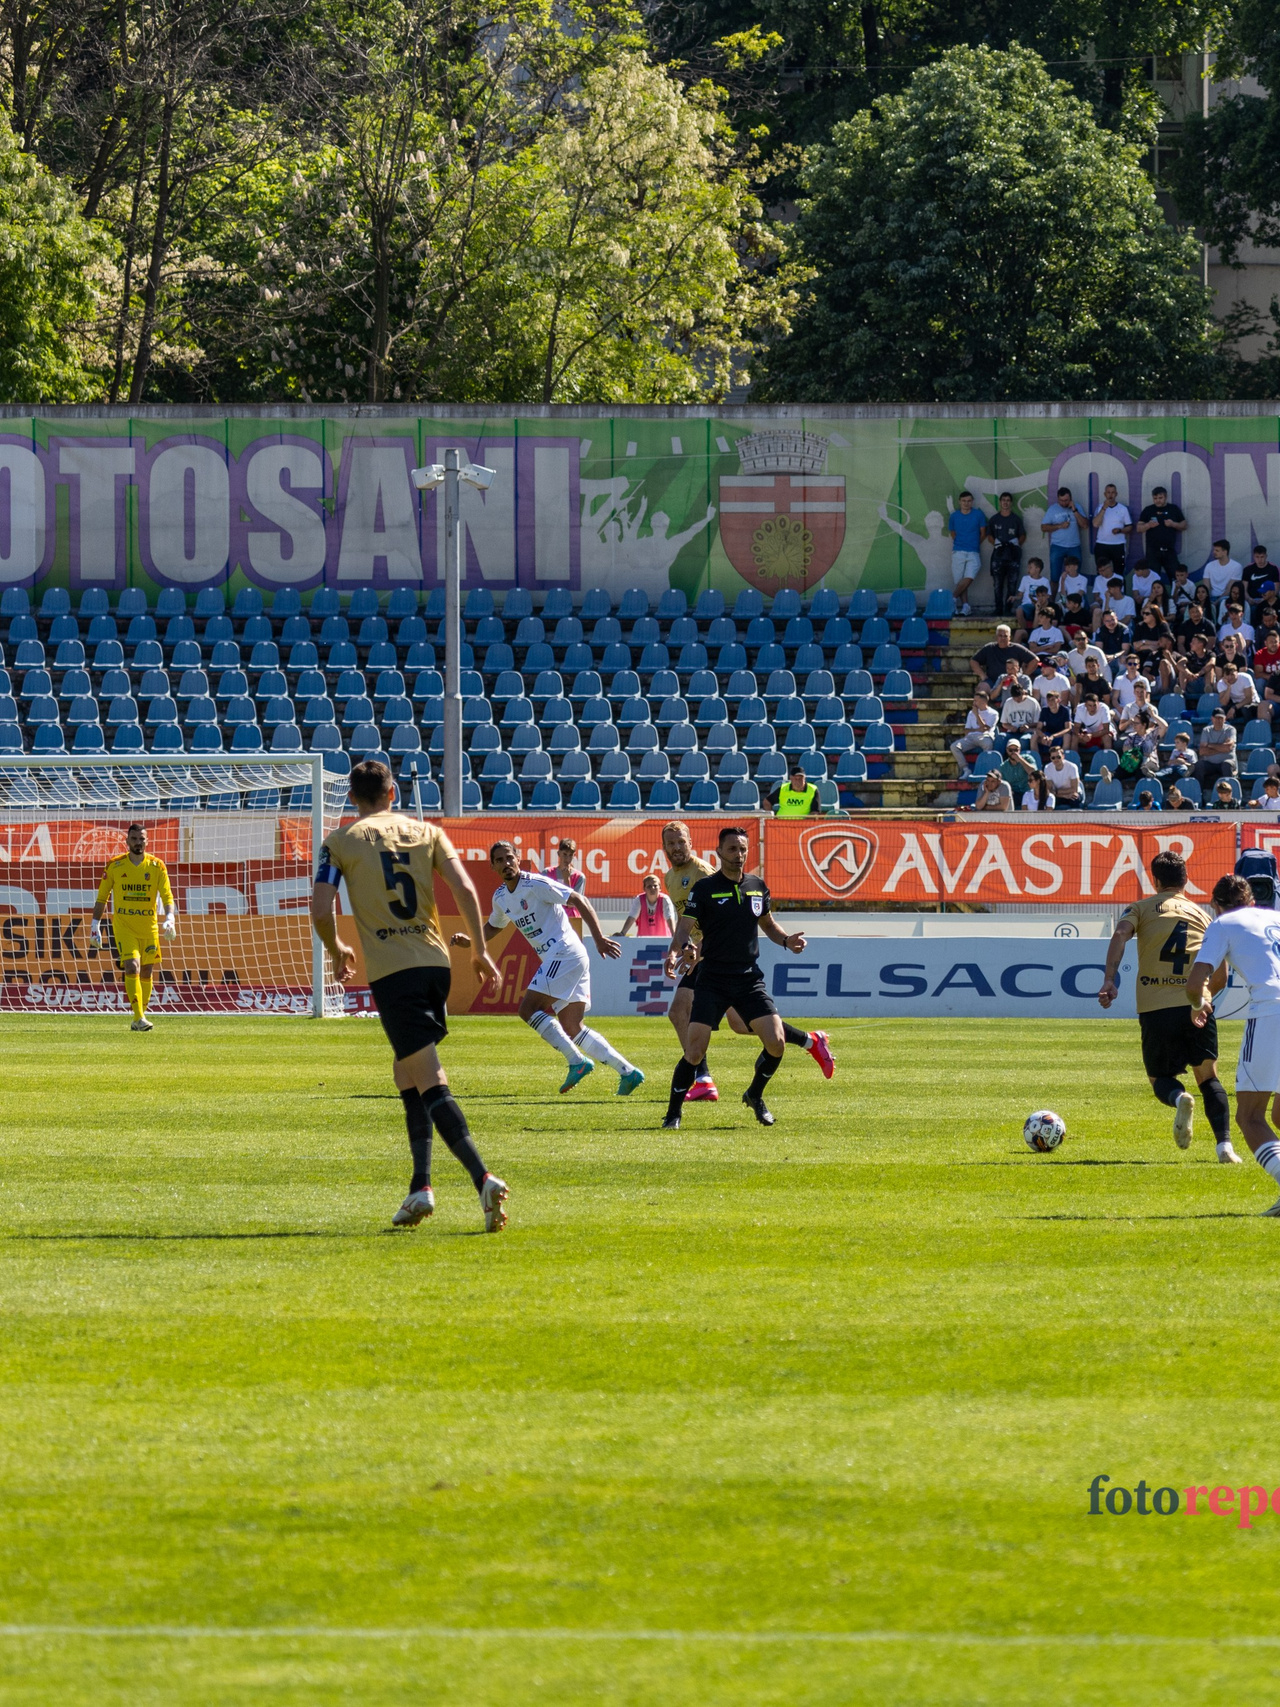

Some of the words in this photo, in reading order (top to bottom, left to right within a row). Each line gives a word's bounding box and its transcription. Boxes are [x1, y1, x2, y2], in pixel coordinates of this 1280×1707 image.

[379, 851, 418, 920] 5
[881, 833, 1207, 896] AVASTAR
[121, 884, 152, 892] UNIBET
[117, 907, 155, 917] ELSACO
[2, 917, 121, 959] SIKA
[1159, 920, 1191, 975] 4
[482, 954, 529, 1005] Sik
[771, 963, 1121, 998] ELSACO
